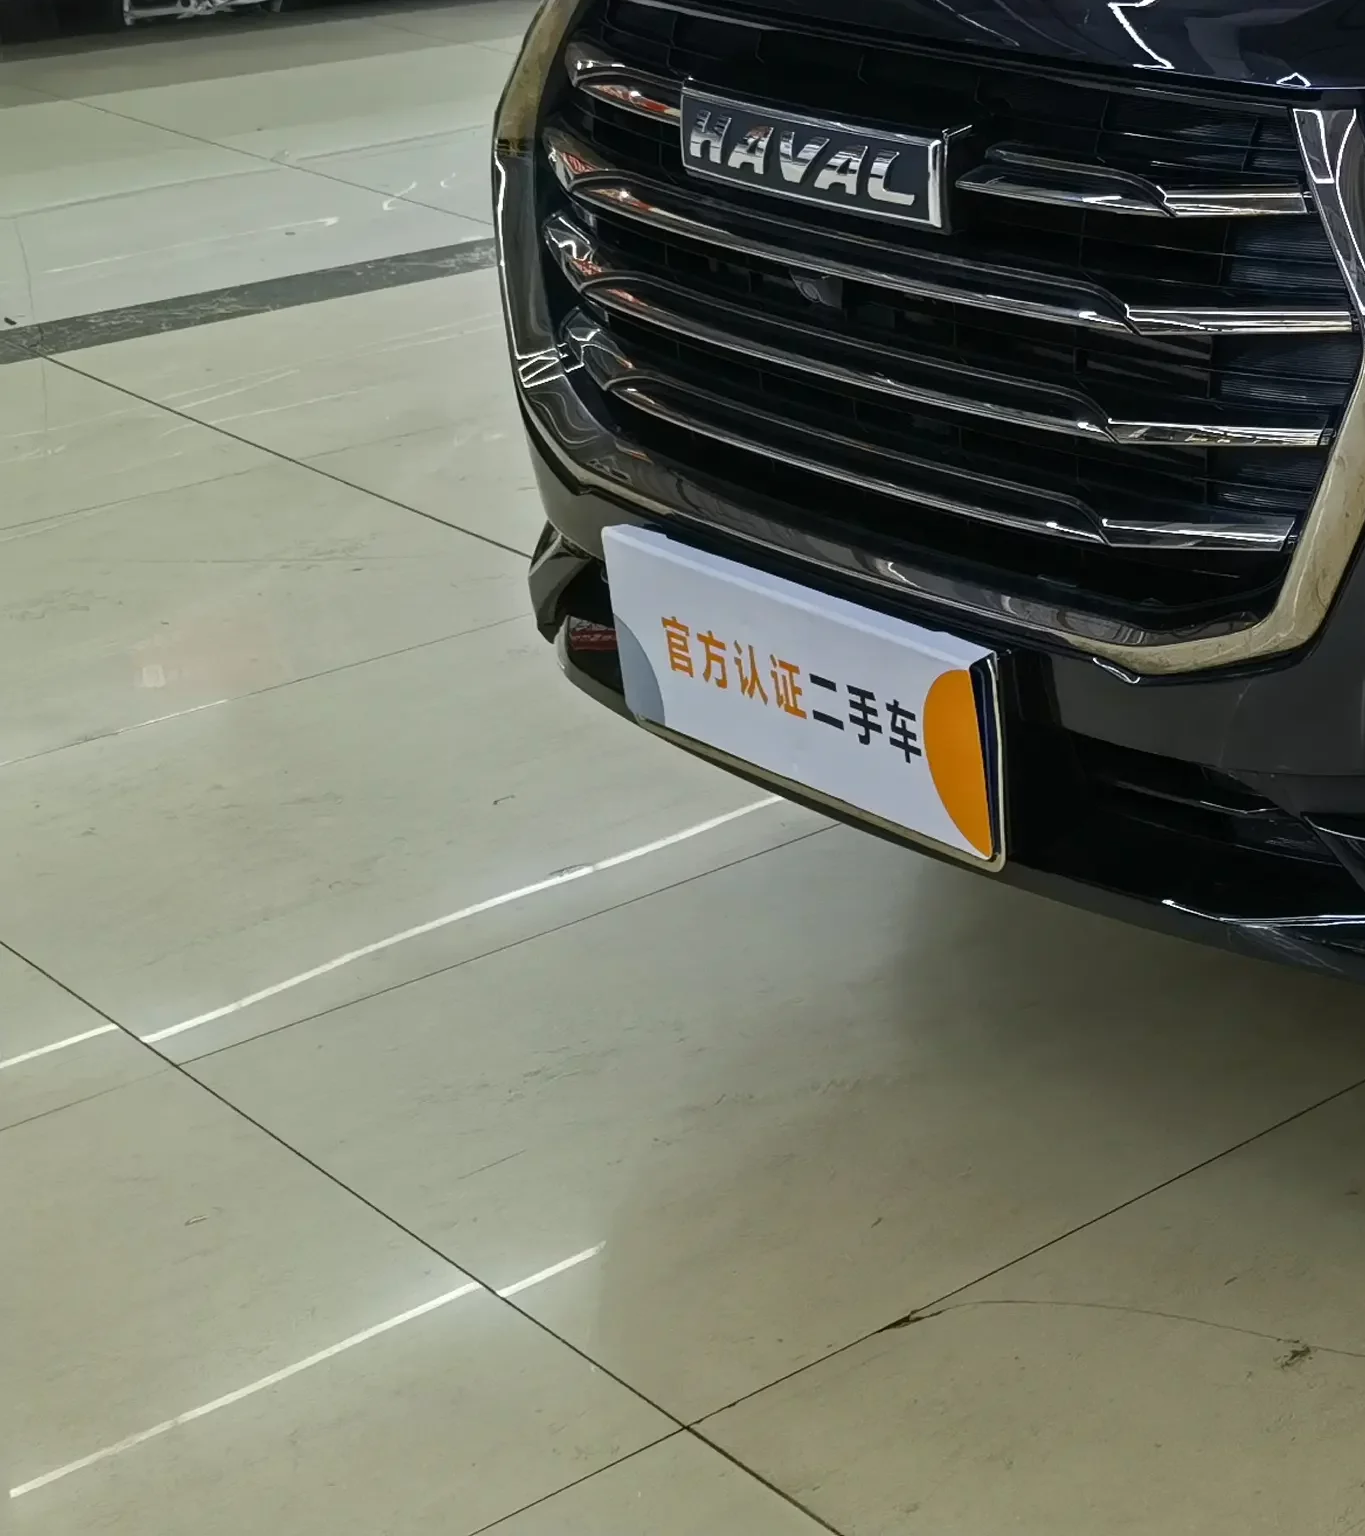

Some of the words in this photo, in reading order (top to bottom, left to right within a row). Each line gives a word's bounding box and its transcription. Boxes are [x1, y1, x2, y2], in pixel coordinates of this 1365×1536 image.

[689, 110, 916, 206] HAVAL
[661, 615, 922, 764] 官方认证二手车
